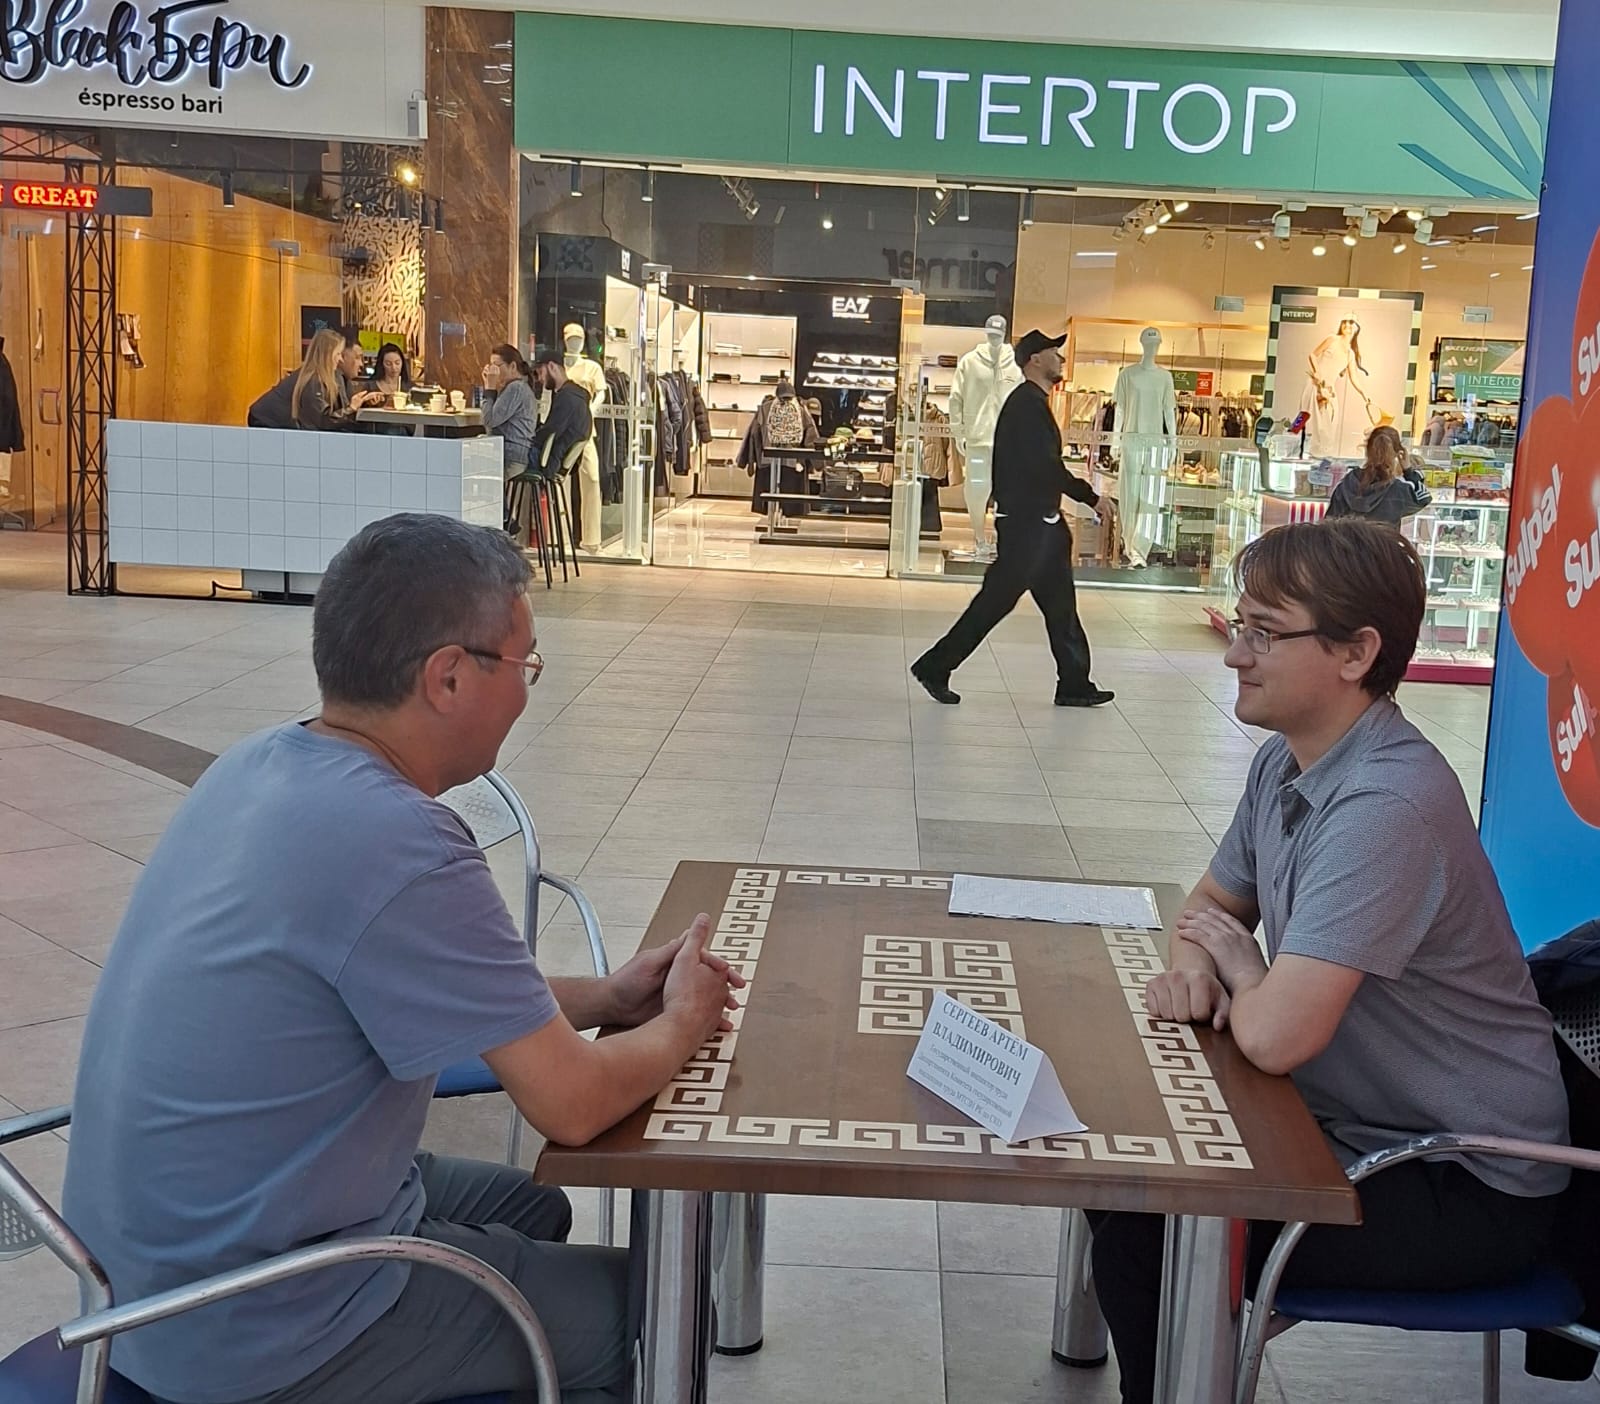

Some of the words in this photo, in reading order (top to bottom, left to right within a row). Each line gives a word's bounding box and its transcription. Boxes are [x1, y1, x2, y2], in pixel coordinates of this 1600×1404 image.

[181, 93, 223, 113] bari
[813, 64, 1297, 155] INTERTOP
[13, 185, 98, 208] GREAT
[832, 296, 870, 313] EA7
[1282, 310, 1315, 318] INTERTOP
[942, 1000, 990, 1037] СЕРГЕЕВ
[932, 1021, 1022, 1086] ВЛАДИМИРОВИЧ
